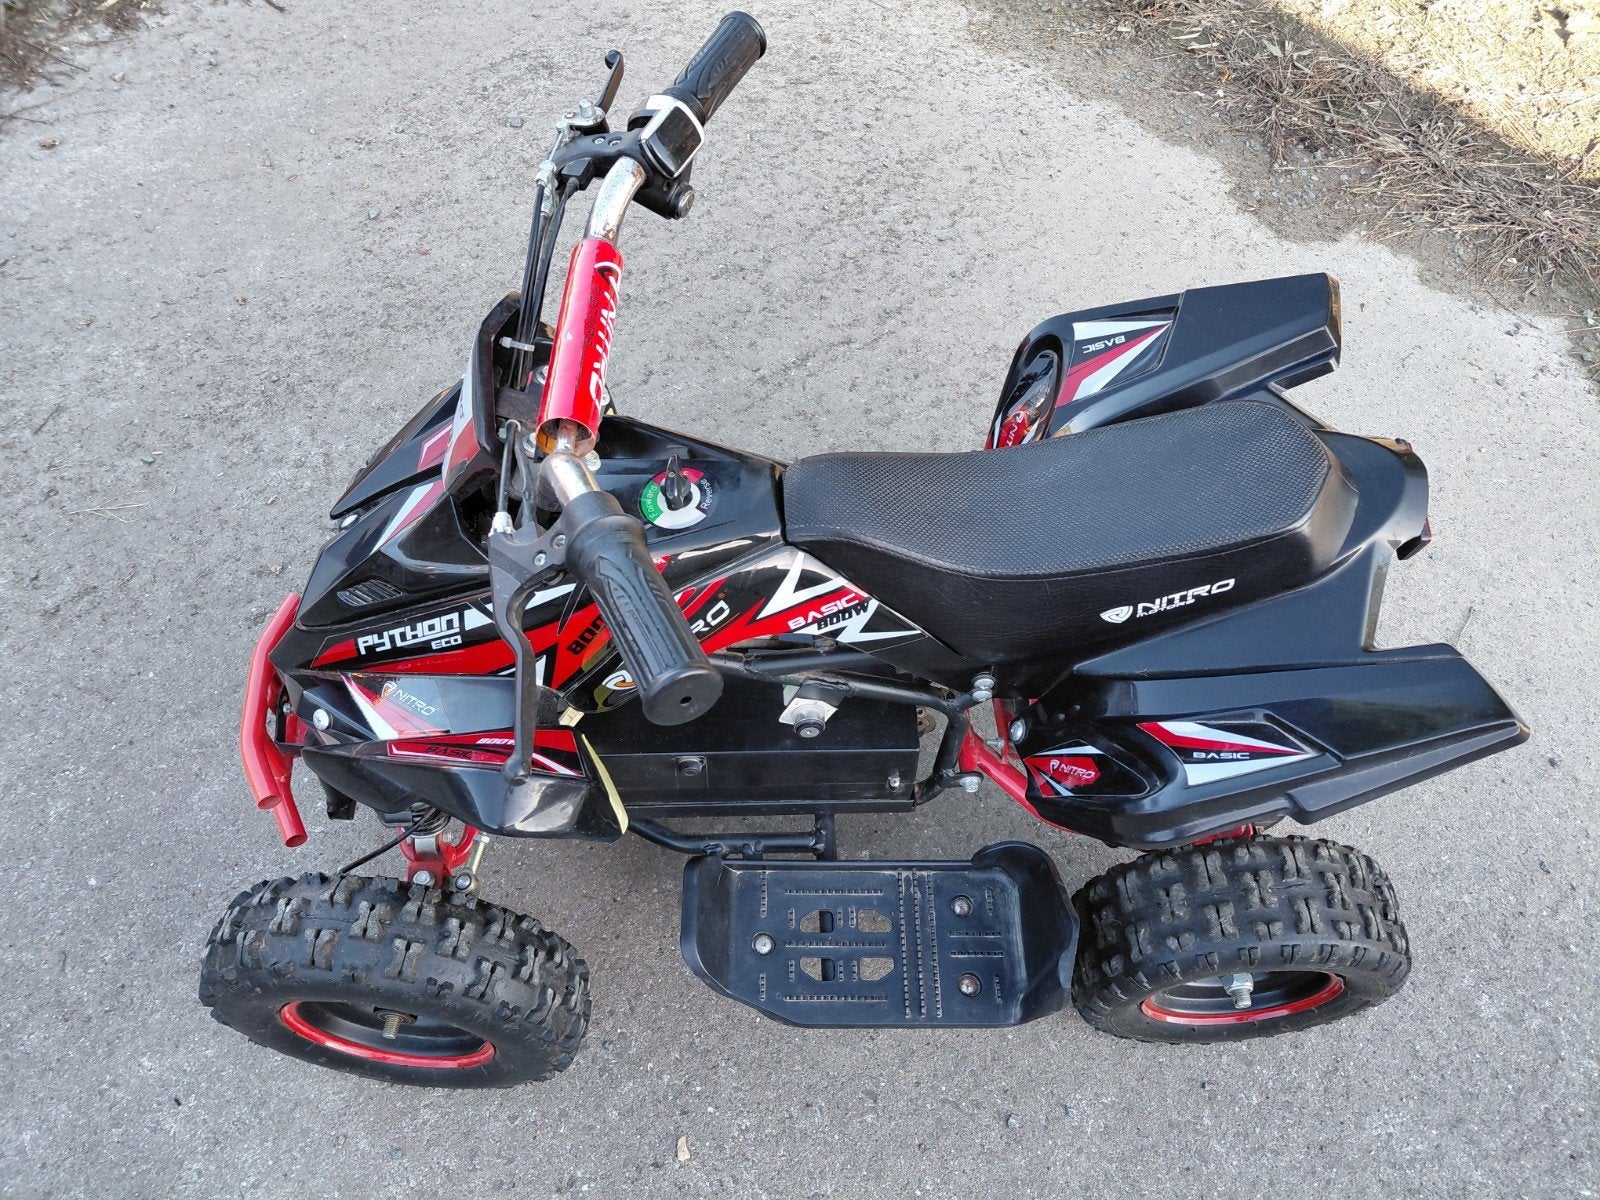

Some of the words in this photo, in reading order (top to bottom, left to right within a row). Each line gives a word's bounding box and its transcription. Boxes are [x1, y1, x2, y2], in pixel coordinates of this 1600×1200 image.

[1082, 335, 1126, 354] BASIC
[645, 485, 659, 519] Forward
[700, 478, 713, 510] Reverse
[787, 592, 860, 631] BASIC
[816, 599, 870, 631] 800W
[357, 612, 460, 656] PYTHON
[431, 634, 463, 650] ECO
[391, 689, 438, 716] NITRO
[1192, 751, 1251, 760] BASIC
[1058, 763, 1096, 779] NITRO
